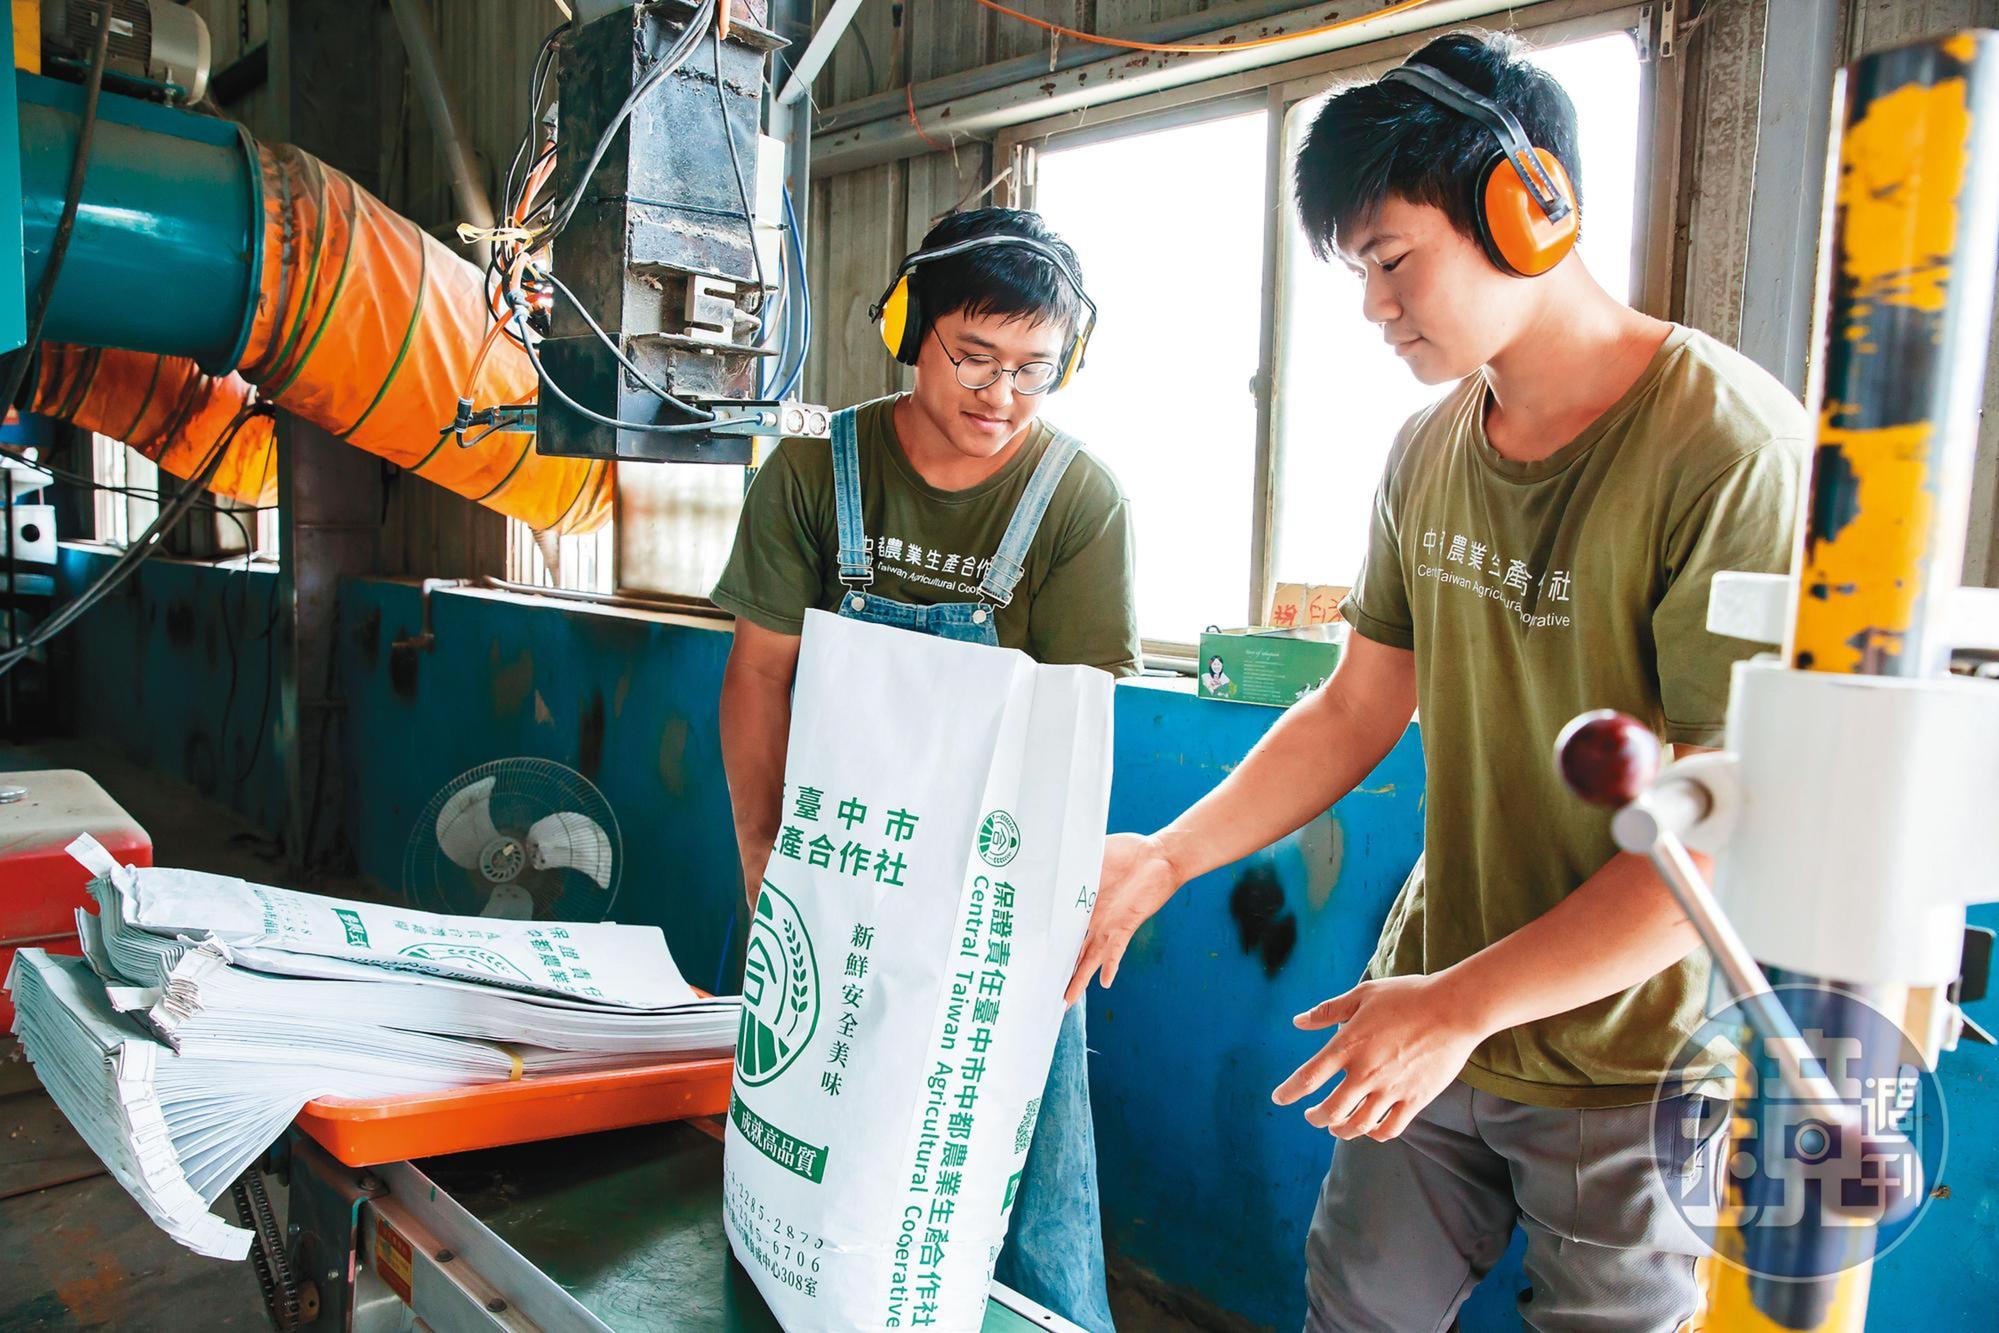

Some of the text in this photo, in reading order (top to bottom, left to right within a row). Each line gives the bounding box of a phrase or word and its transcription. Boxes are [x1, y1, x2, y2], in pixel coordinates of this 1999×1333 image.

[783, 783, 920, 843] 臺中市
[772, 823, 908, 887] 產合作社
[959, 874, 990, 958] Central
[820, 922, 876, 1096] 新鮮安全美味
[940, 970, 975, 1050] Taiwan
[740, 1110, 818, 1178] 成就高品質
[909, 1060, 953, 1193] Agricultural
